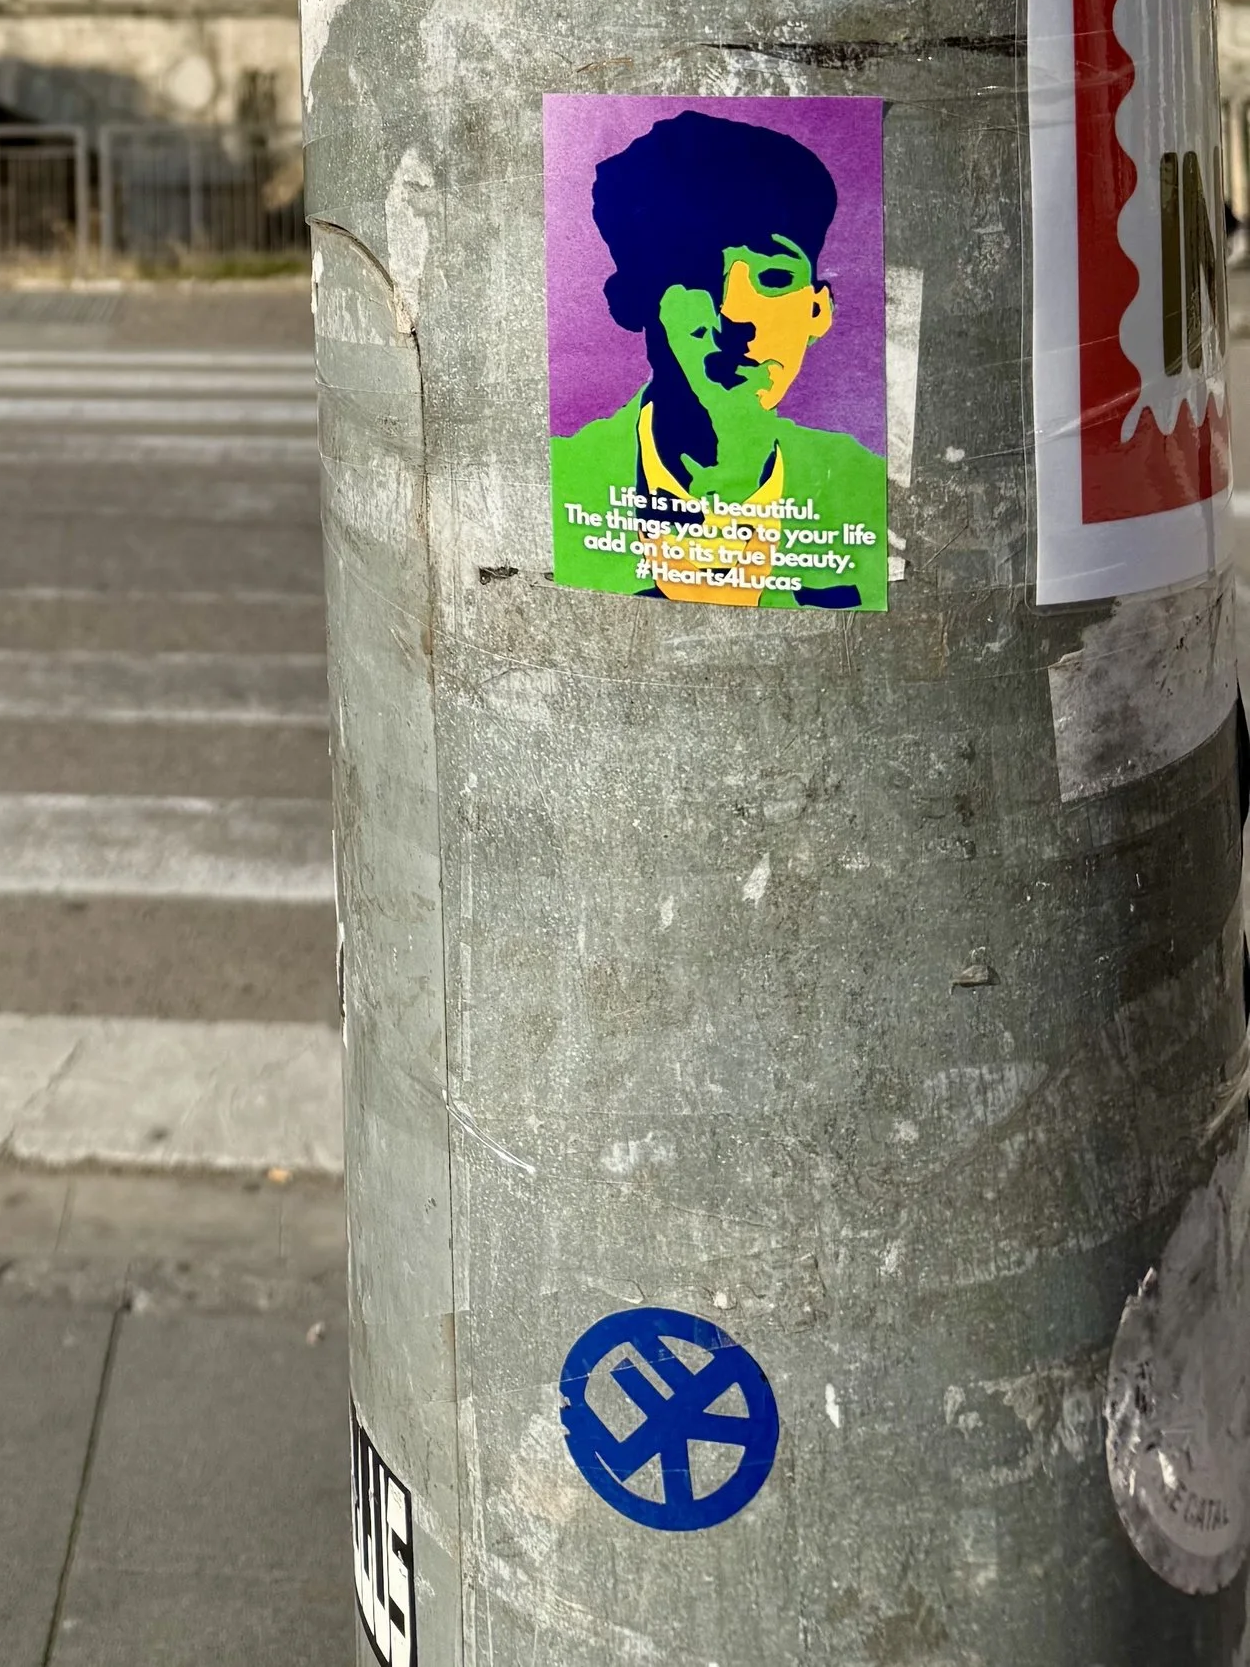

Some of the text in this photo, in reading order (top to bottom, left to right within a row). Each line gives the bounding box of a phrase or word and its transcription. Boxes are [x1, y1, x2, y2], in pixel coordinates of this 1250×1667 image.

[609, 485, 821, 521] Life is not beautiful.
[564, 502, 877, 549] The things you do to your life
[583, 530, 856, 574] add on to its true beauty.
[635, 557, 802, 591] #Hearts4Lucas
